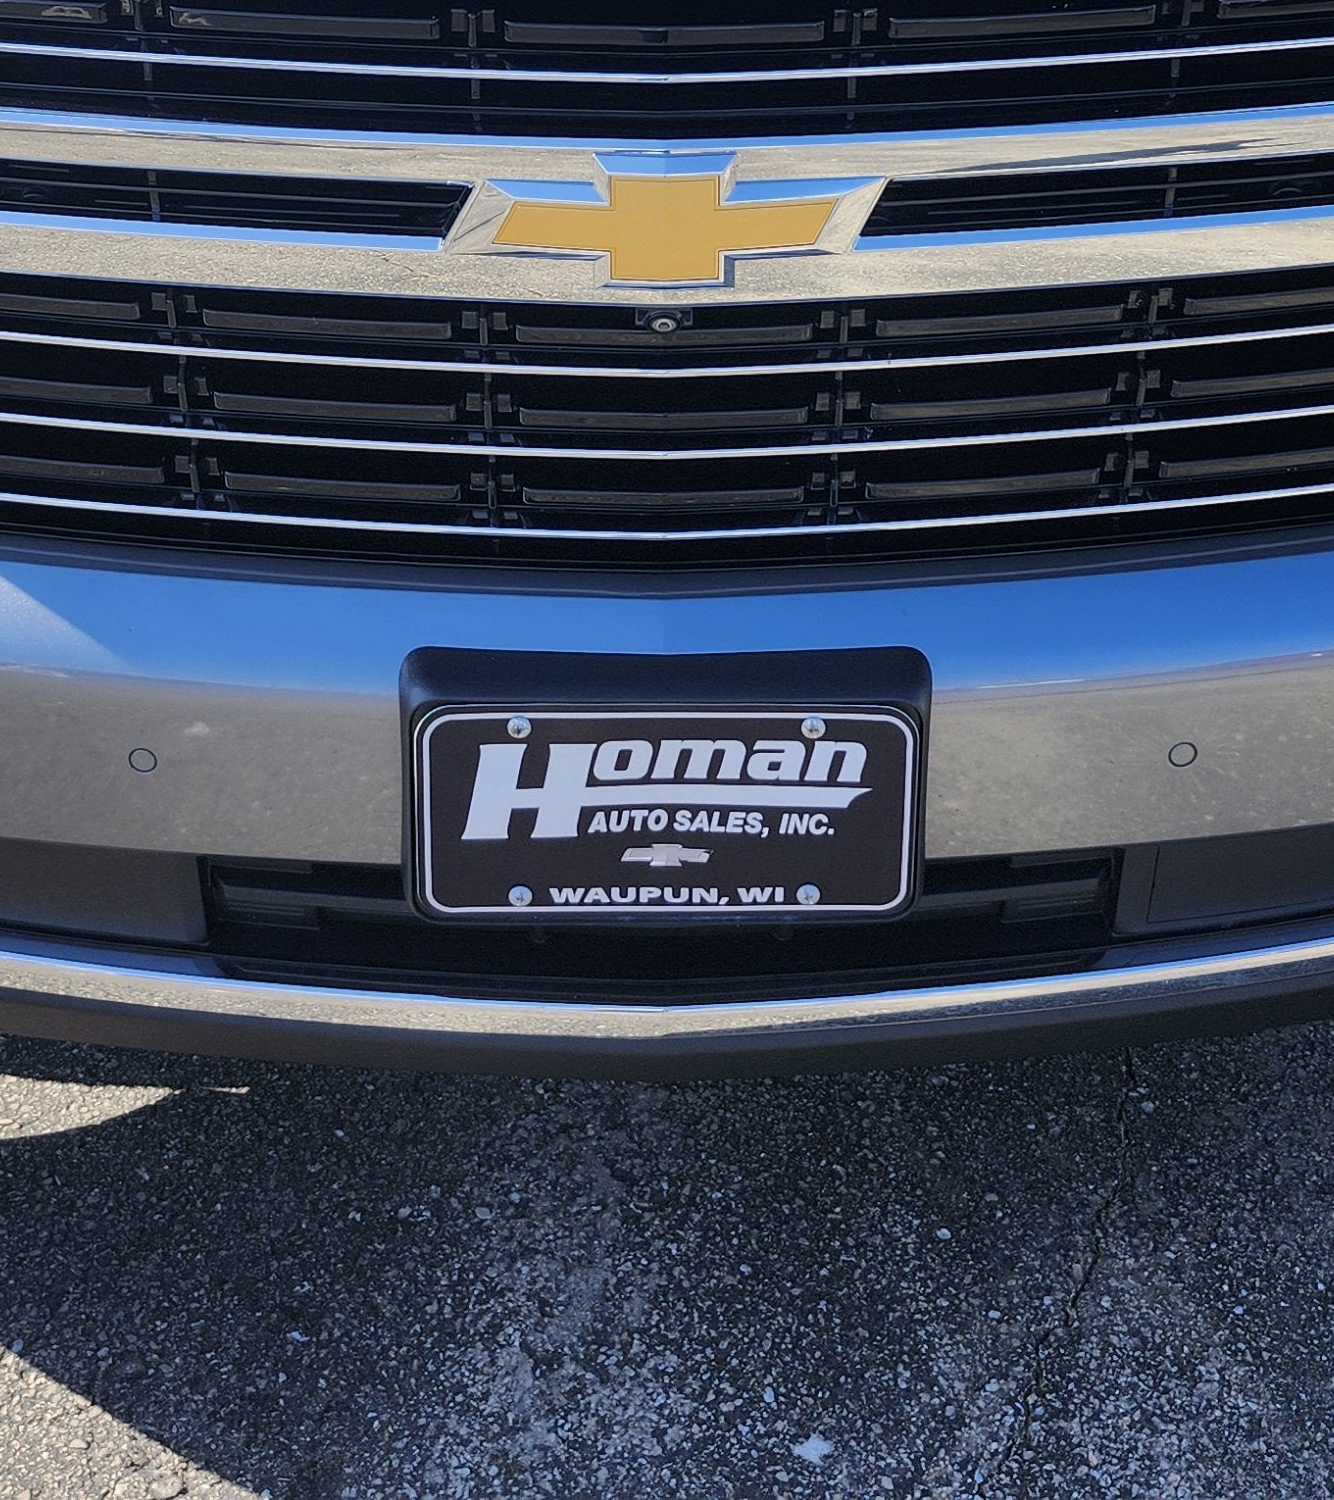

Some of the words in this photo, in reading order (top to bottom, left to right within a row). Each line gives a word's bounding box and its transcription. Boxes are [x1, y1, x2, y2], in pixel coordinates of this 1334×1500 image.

[587, 809, 669, 834] AUTO
[673, 810, 769, 838] SALES,
[778, 813, 835, 835] INC.
[549, 886, 729, 905] WAUPUN,
[737, 886, 785, 903] WI
